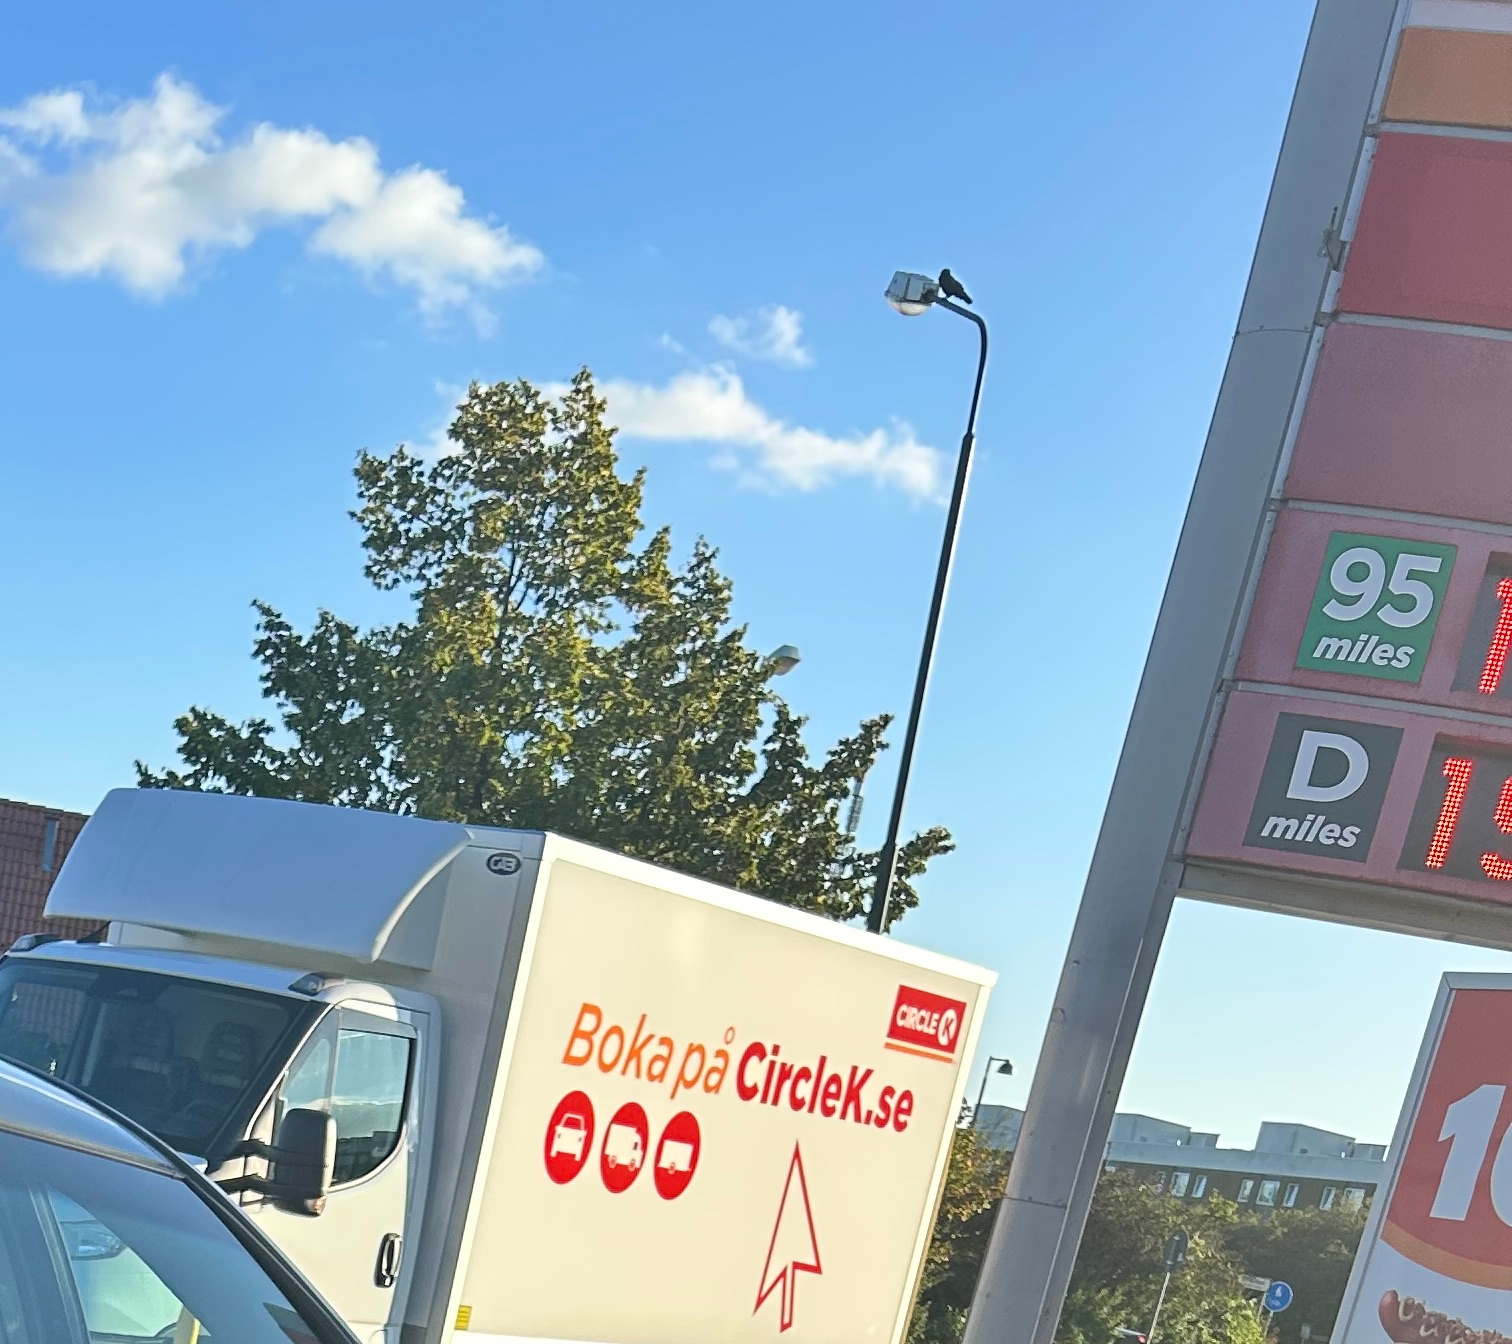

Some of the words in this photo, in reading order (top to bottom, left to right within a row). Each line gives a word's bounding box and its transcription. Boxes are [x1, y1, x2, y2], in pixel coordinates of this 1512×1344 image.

[1322, 547, 1442, 628] 95
[1312, 634, 1416, 668] miles
[1287, 730, 1369, 802] D
[1261, 814, 1362, 848] miles
[896, 1004, 941, 1036] CIRCLE
[940, 1012, 956, 1045] K
[561, 1002, 675, 1083] Boka
[670, 1026, 735, 1100] på
[736, 1042, 914, 1132] CircleK.se
